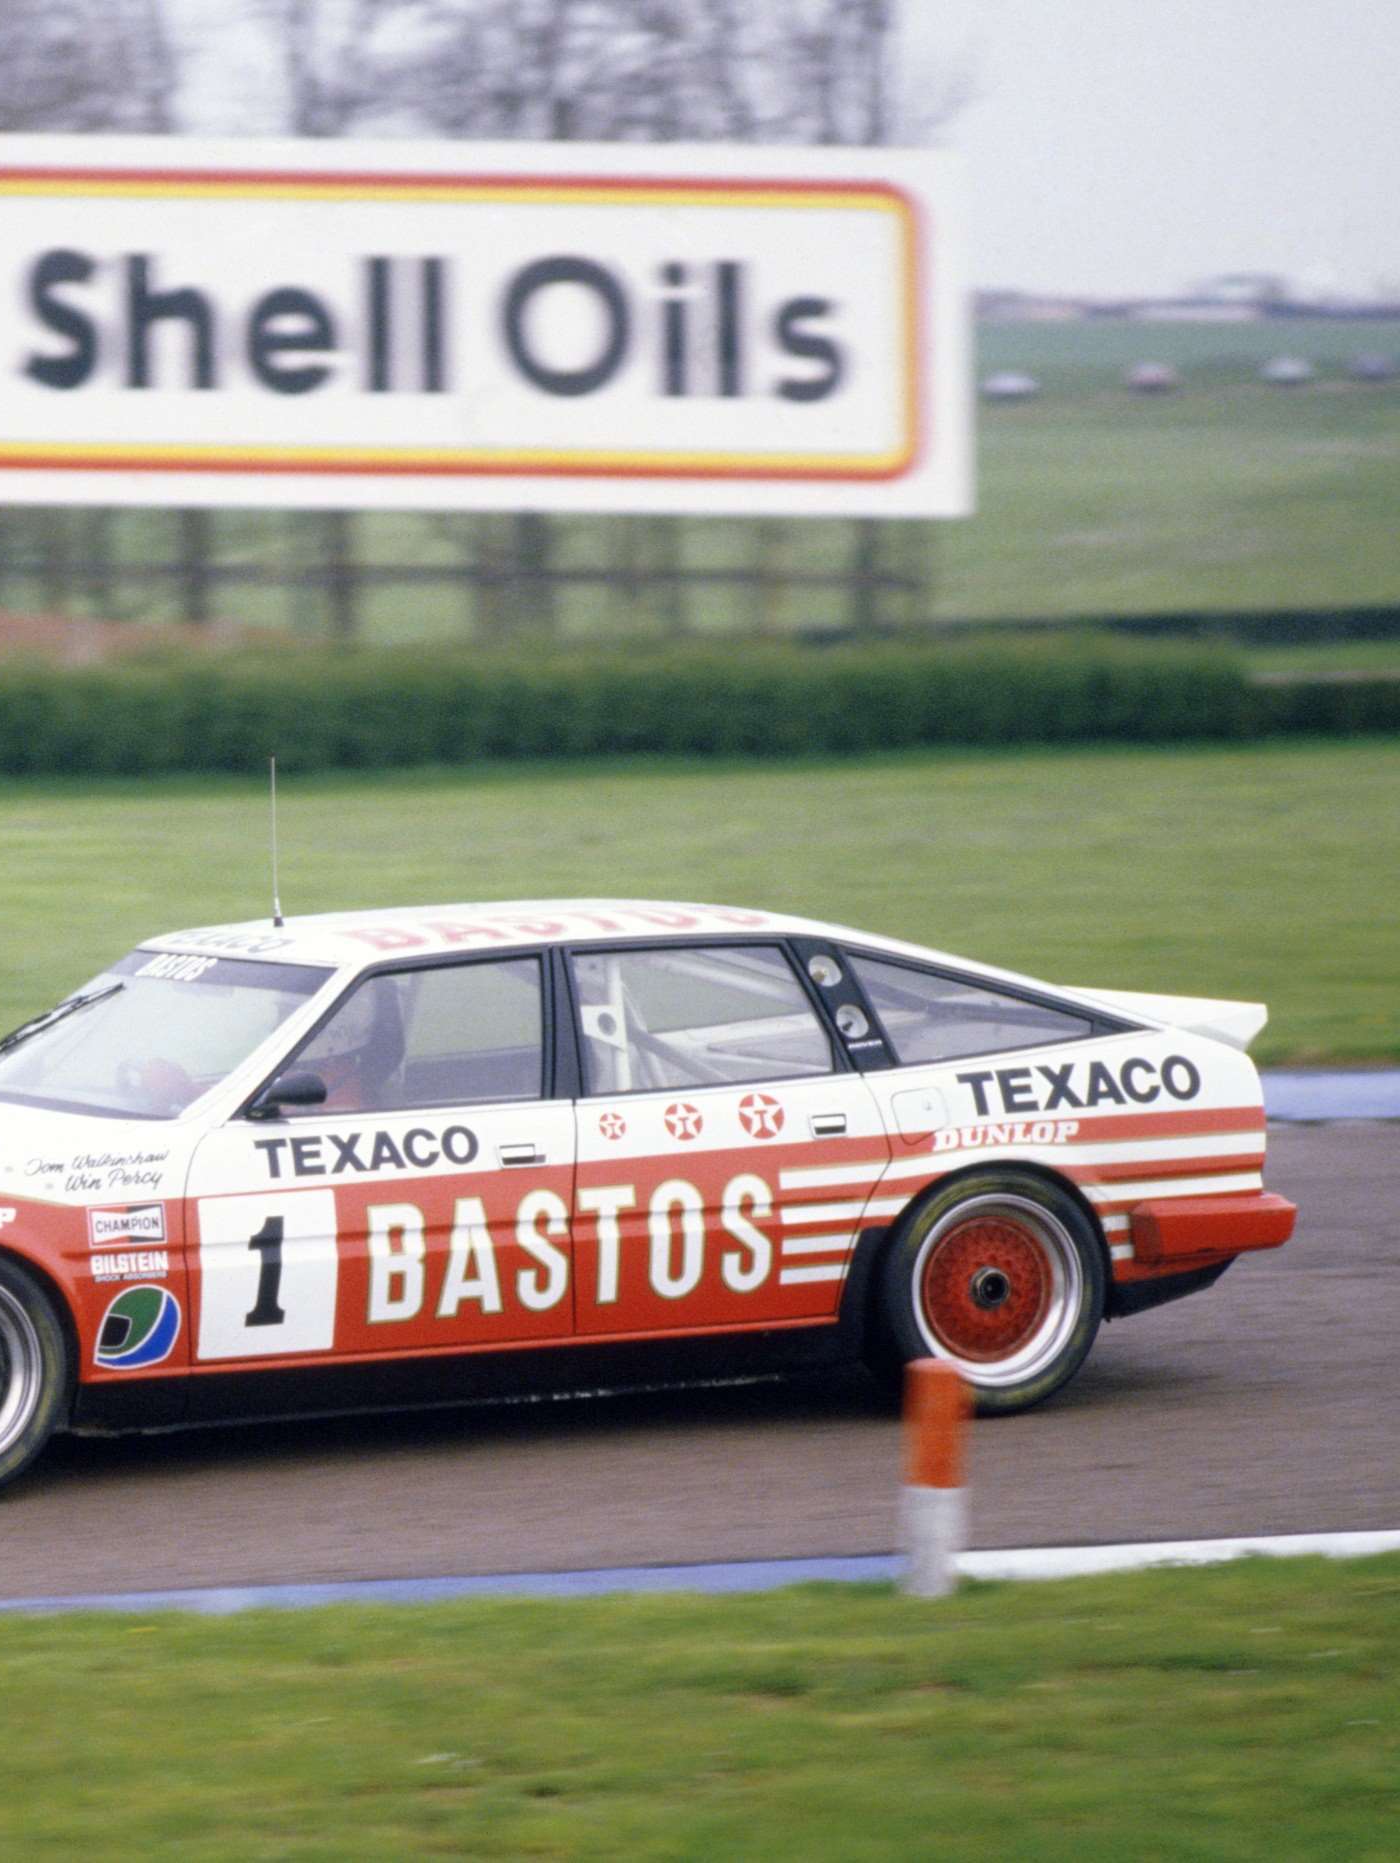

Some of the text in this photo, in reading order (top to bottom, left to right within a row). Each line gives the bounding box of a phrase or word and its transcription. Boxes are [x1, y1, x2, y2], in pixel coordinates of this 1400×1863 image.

[21, 247, 852, 402] Shell Oils
[957, 1055, 1201, 1117] TEXACO
[254, 1125, 479, 1179] TEXACO
[932, 1121, 1079, 1152] DUNLOP
[65, 1167, 165, 1192] Win Percy
[95, 1216, 160, 1234] CHAMPION
[367, 1173, 774, 1325] BASTOS
[91, 1251, 168, 1275] BILSTEIN
[245, 1216, 286, 1327] 1
